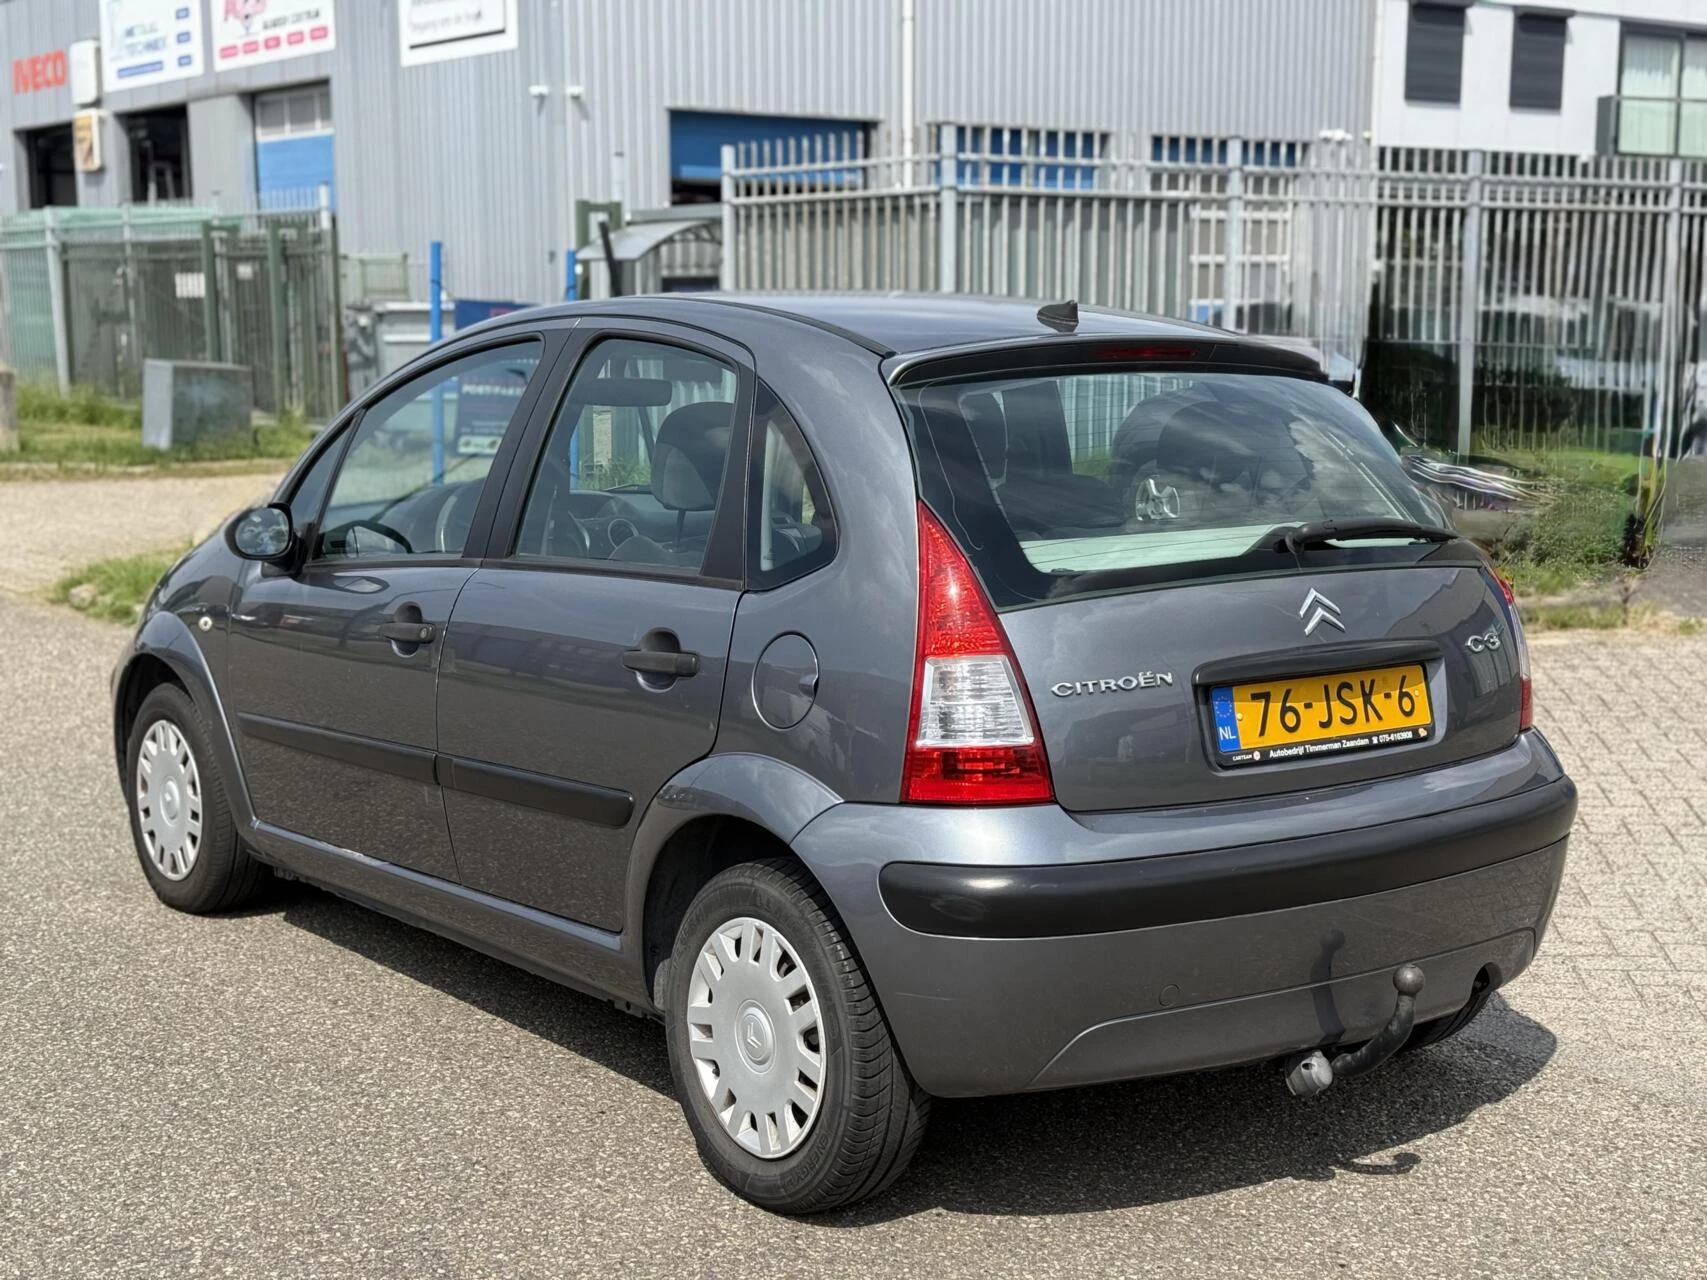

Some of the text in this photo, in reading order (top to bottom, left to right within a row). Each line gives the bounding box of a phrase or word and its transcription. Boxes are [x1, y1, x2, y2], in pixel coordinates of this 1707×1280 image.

[13, 50, 67, 94] IVECO
[1465, 632, 1501, 652] C3
[1051, 671, 1173, 697] CITROËN
[1250, 675, 1415, 737] 76-JSK-6
[1218, 726, 1237, 740] NL
[1269, 745, 1305, 759] Autobedrijf
[1305, 742, 1341, 753] Timmerman
[1341, 737, 1370, 748] Zaandam
